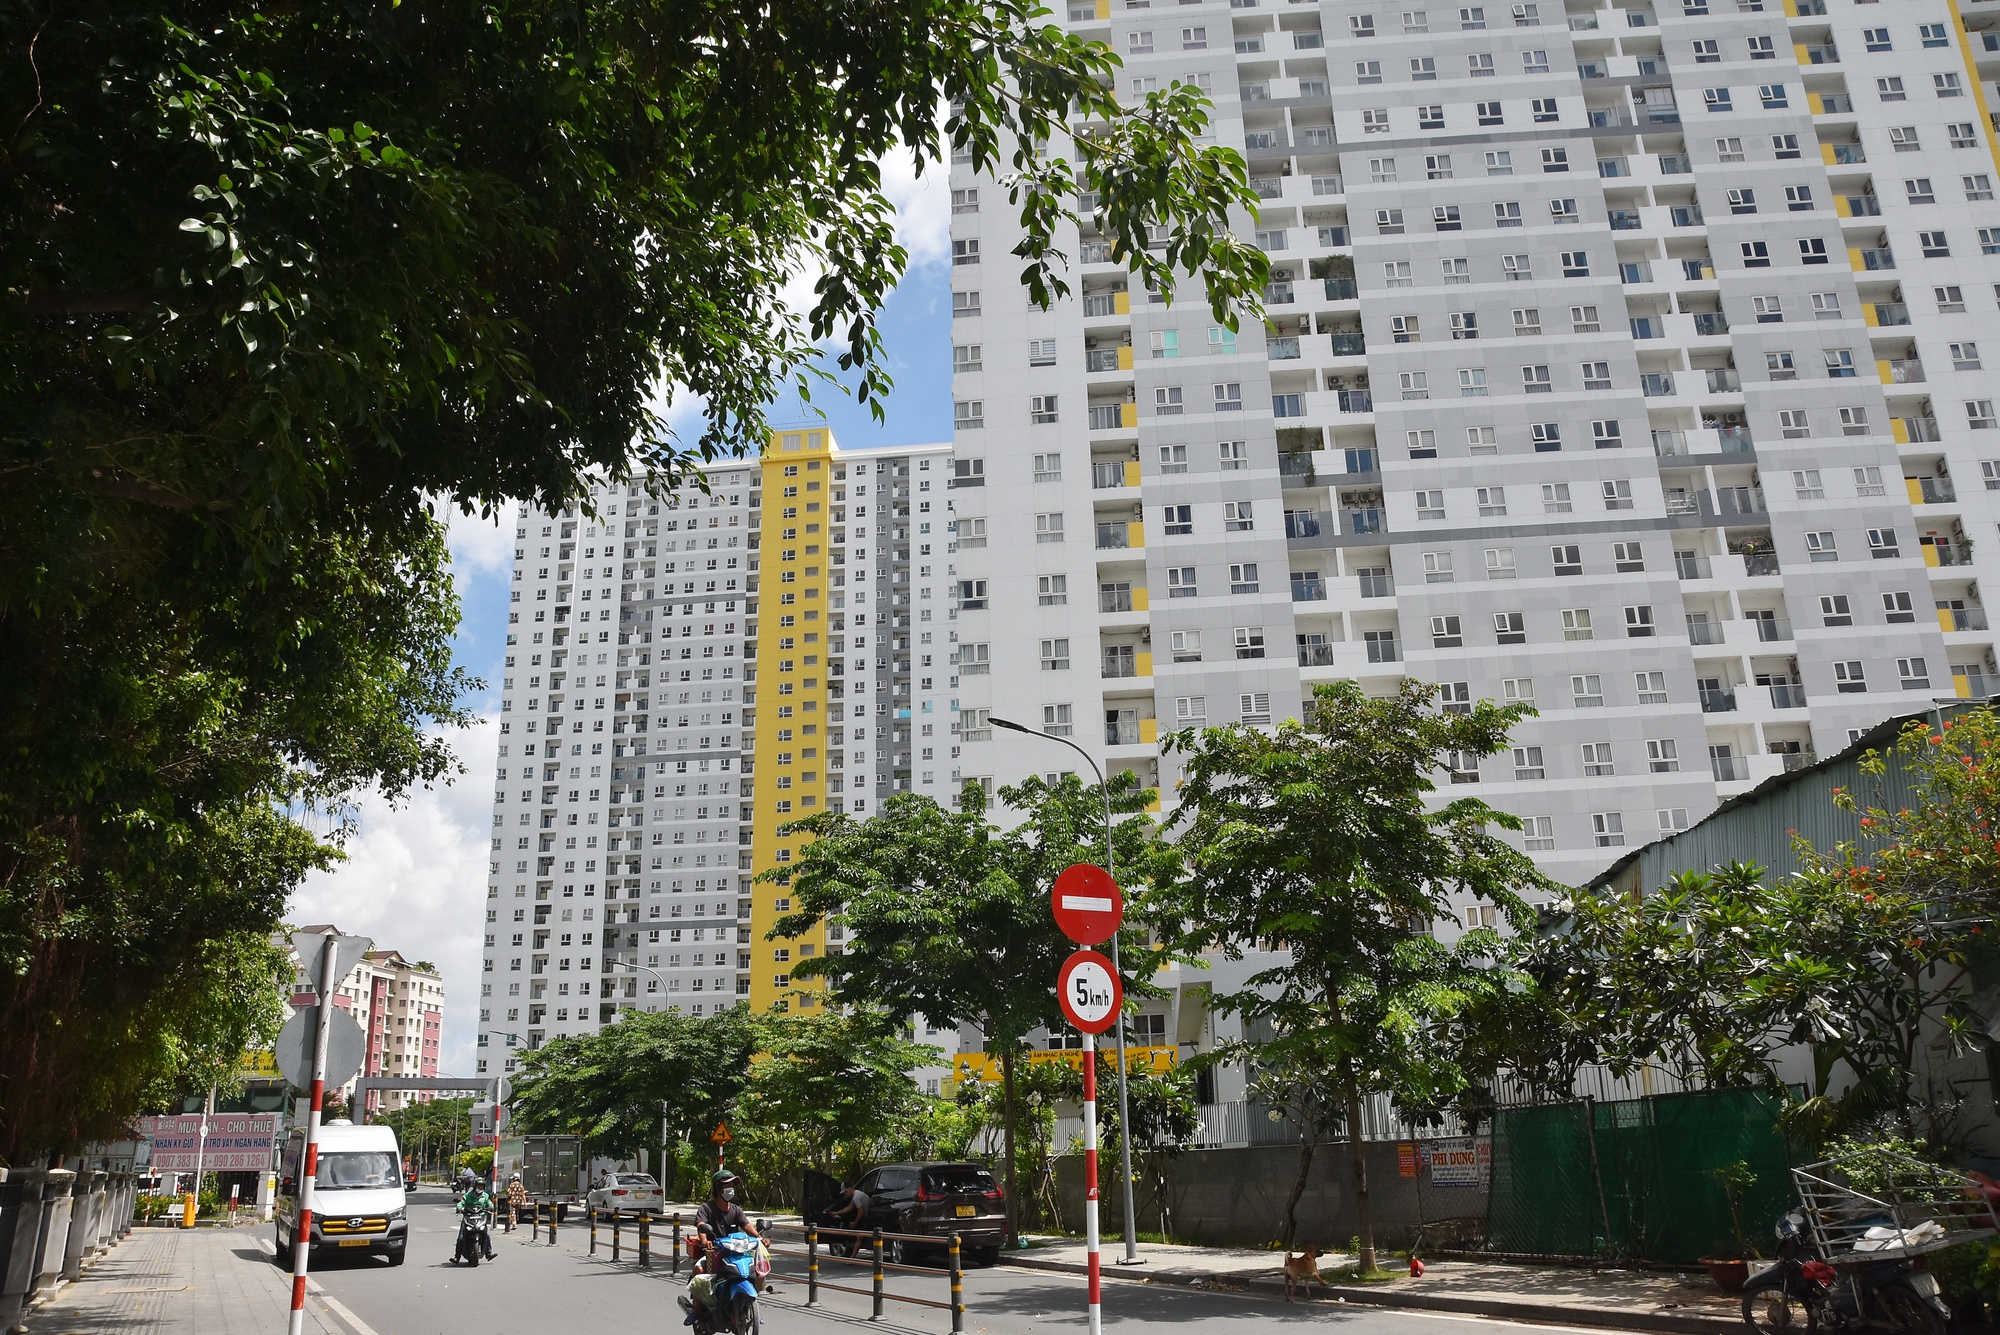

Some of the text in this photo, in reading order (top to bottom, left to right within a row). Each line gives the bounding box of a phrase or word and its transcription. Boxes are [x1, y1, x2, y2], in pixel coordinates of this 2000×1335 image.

[1076, 978, 1110, 1007] 5 km/h
[178, 1121, 197, 1134] MUA
[227, 1121, 246, 1134] CHO
[248, 1117, 272, 1133] THUÊ
[154, 1136, 172, 1151] NHẬN
[222, 1138, 234, 1148] VAY
[234, 1136, 252, 1148] NGÂN
[253, 1136, 271, 1148] HÀNG
[156, 1154, 176, 1168] 0907
[176, 1154, 191, 1168] 383
[213, 1153, 228, 1168] 090
[229, 1153, 245, 1167] 286
[246, 1153, 266, 1167] 1264
[1432, 1153, 1447, 1166] PHI
[1449, 1151, 1475, 1165] DUNG
